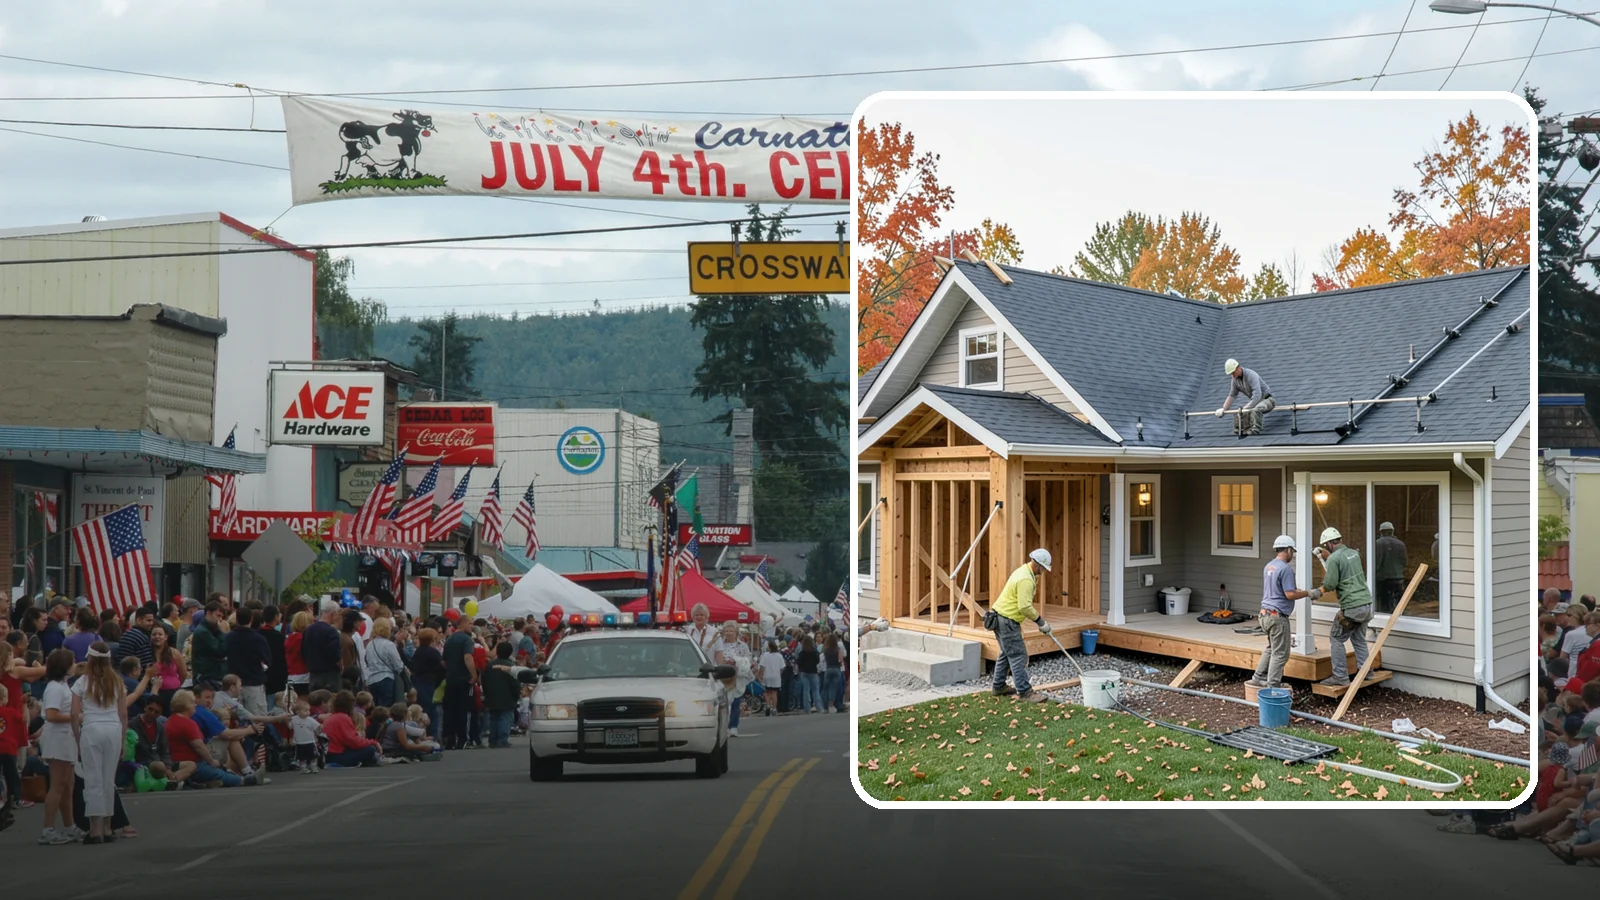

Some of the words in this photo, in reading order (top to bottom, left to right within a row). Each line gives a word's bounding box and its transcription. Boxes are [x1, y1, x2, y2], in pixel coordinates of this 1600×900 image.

[481, 140, 605, 193] JULY
[632, 150, 746, 198] 4th.
[697, 254, 850, 280] CROSSWA
[283, 380, 373, 420] ACE
[405, 409, 452, 422] CEDAR
[461, 409, 485, 422] LOG
[283, 421, 371, 437] Hardware
[416, 428, 477, 447] Coca-Cola
[353, 467, 386, 481] Simpl
[96, 485, 124, 494] Vincent
[126, 486, 136, 494] de
[137, 486, 155, 495] Paul
[81, 503, 154, 522] THT
[212, 515, 331, 536] HARDARE
[688, 526, 741, 535] CRNATION
[699, 535, 730, 543] GLASS
